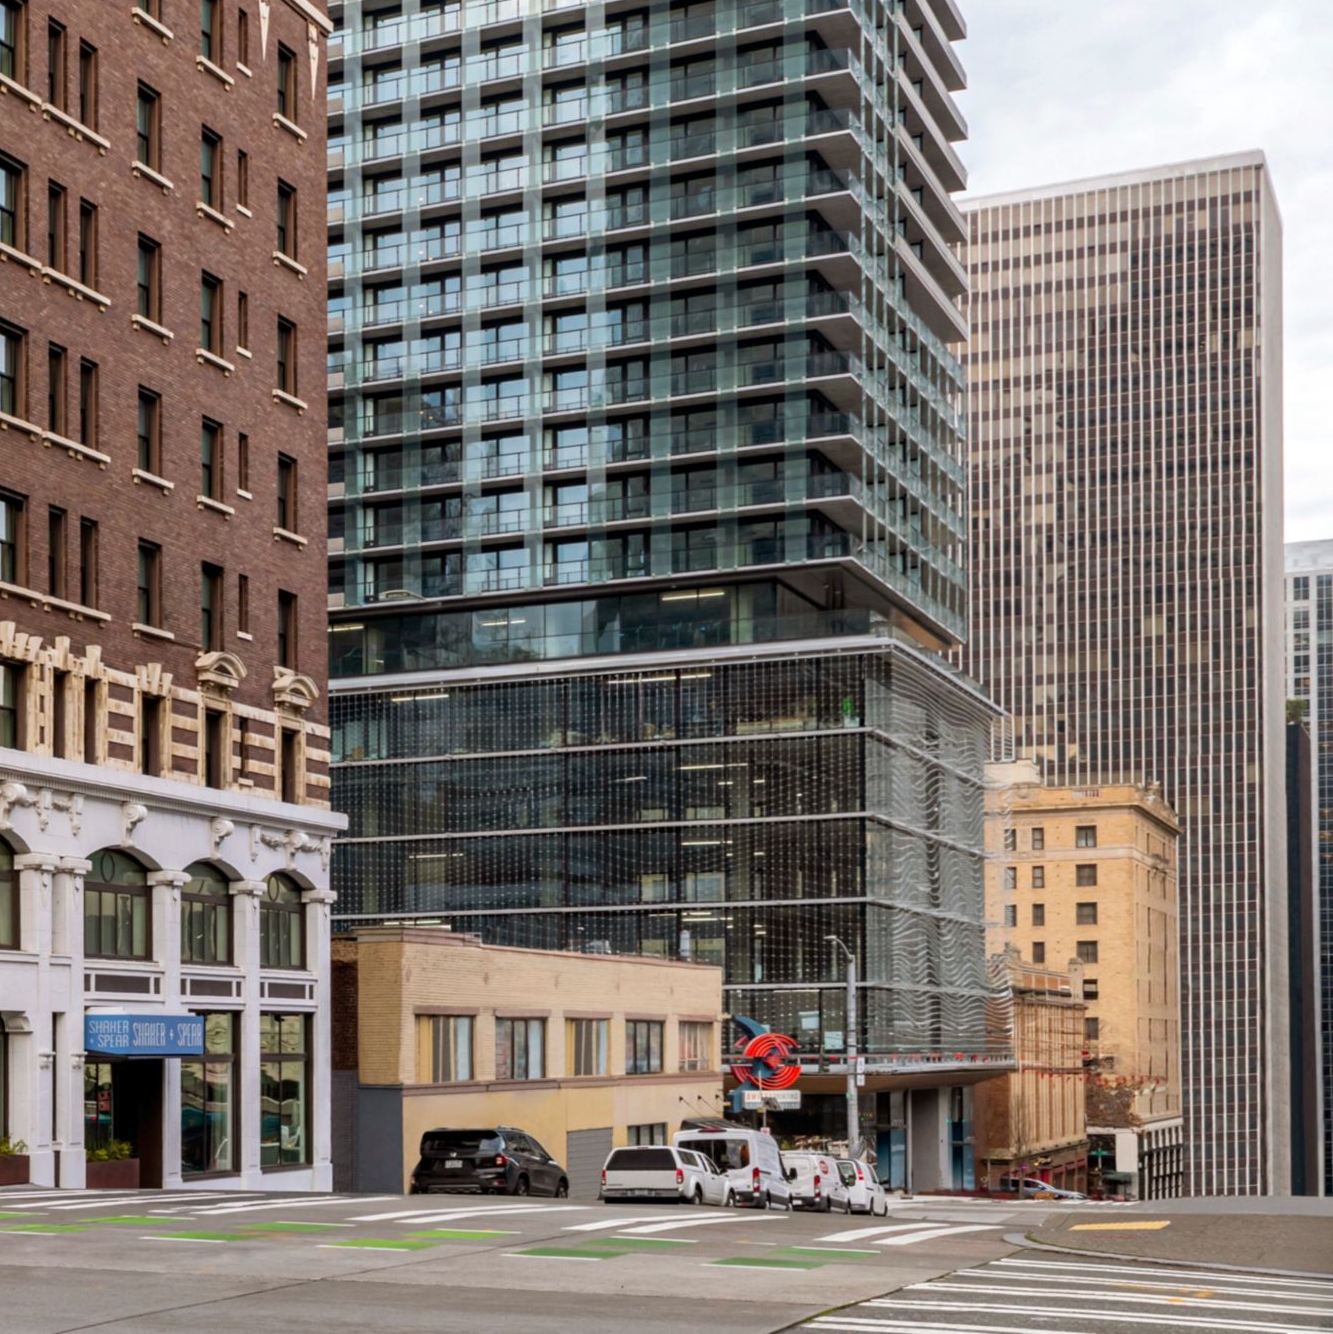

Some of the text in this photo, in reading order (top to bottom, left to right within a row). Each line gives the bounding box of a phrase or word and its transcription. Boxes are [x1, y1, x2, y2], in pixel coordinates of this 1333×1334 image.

[88, 1020, 130, 1035] SHAKER
[133, 1022, 166, 1046] SHAKER
[177, 1023, 202, 1046] SPEAR
[97, 1034, 130, 1048] SPEAR
